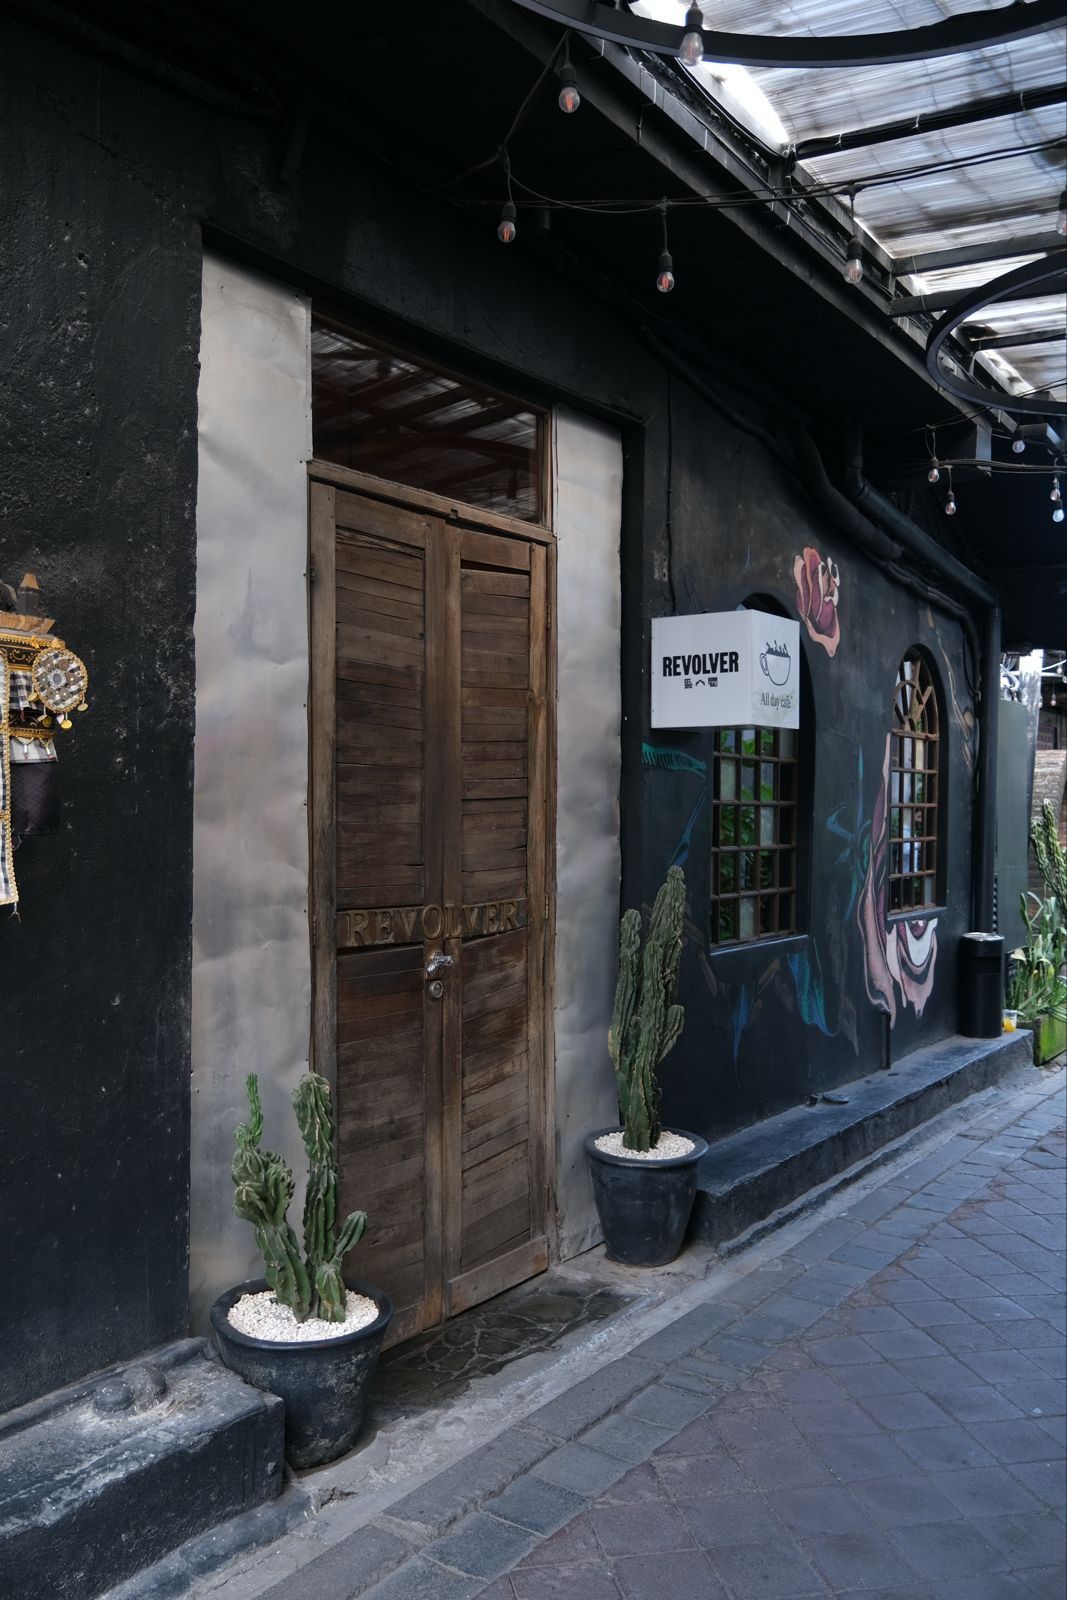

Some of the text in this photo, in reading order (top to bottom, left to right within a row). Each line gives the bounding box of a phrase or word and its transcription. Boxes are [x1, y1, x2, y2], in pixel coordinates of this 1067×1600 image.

[663, 651, 739, 677] REVOLVER
[760, 692, 769, 705] All
[770, 693, 780, 710] day
[346, 902, 519, 946] REVOLVER
